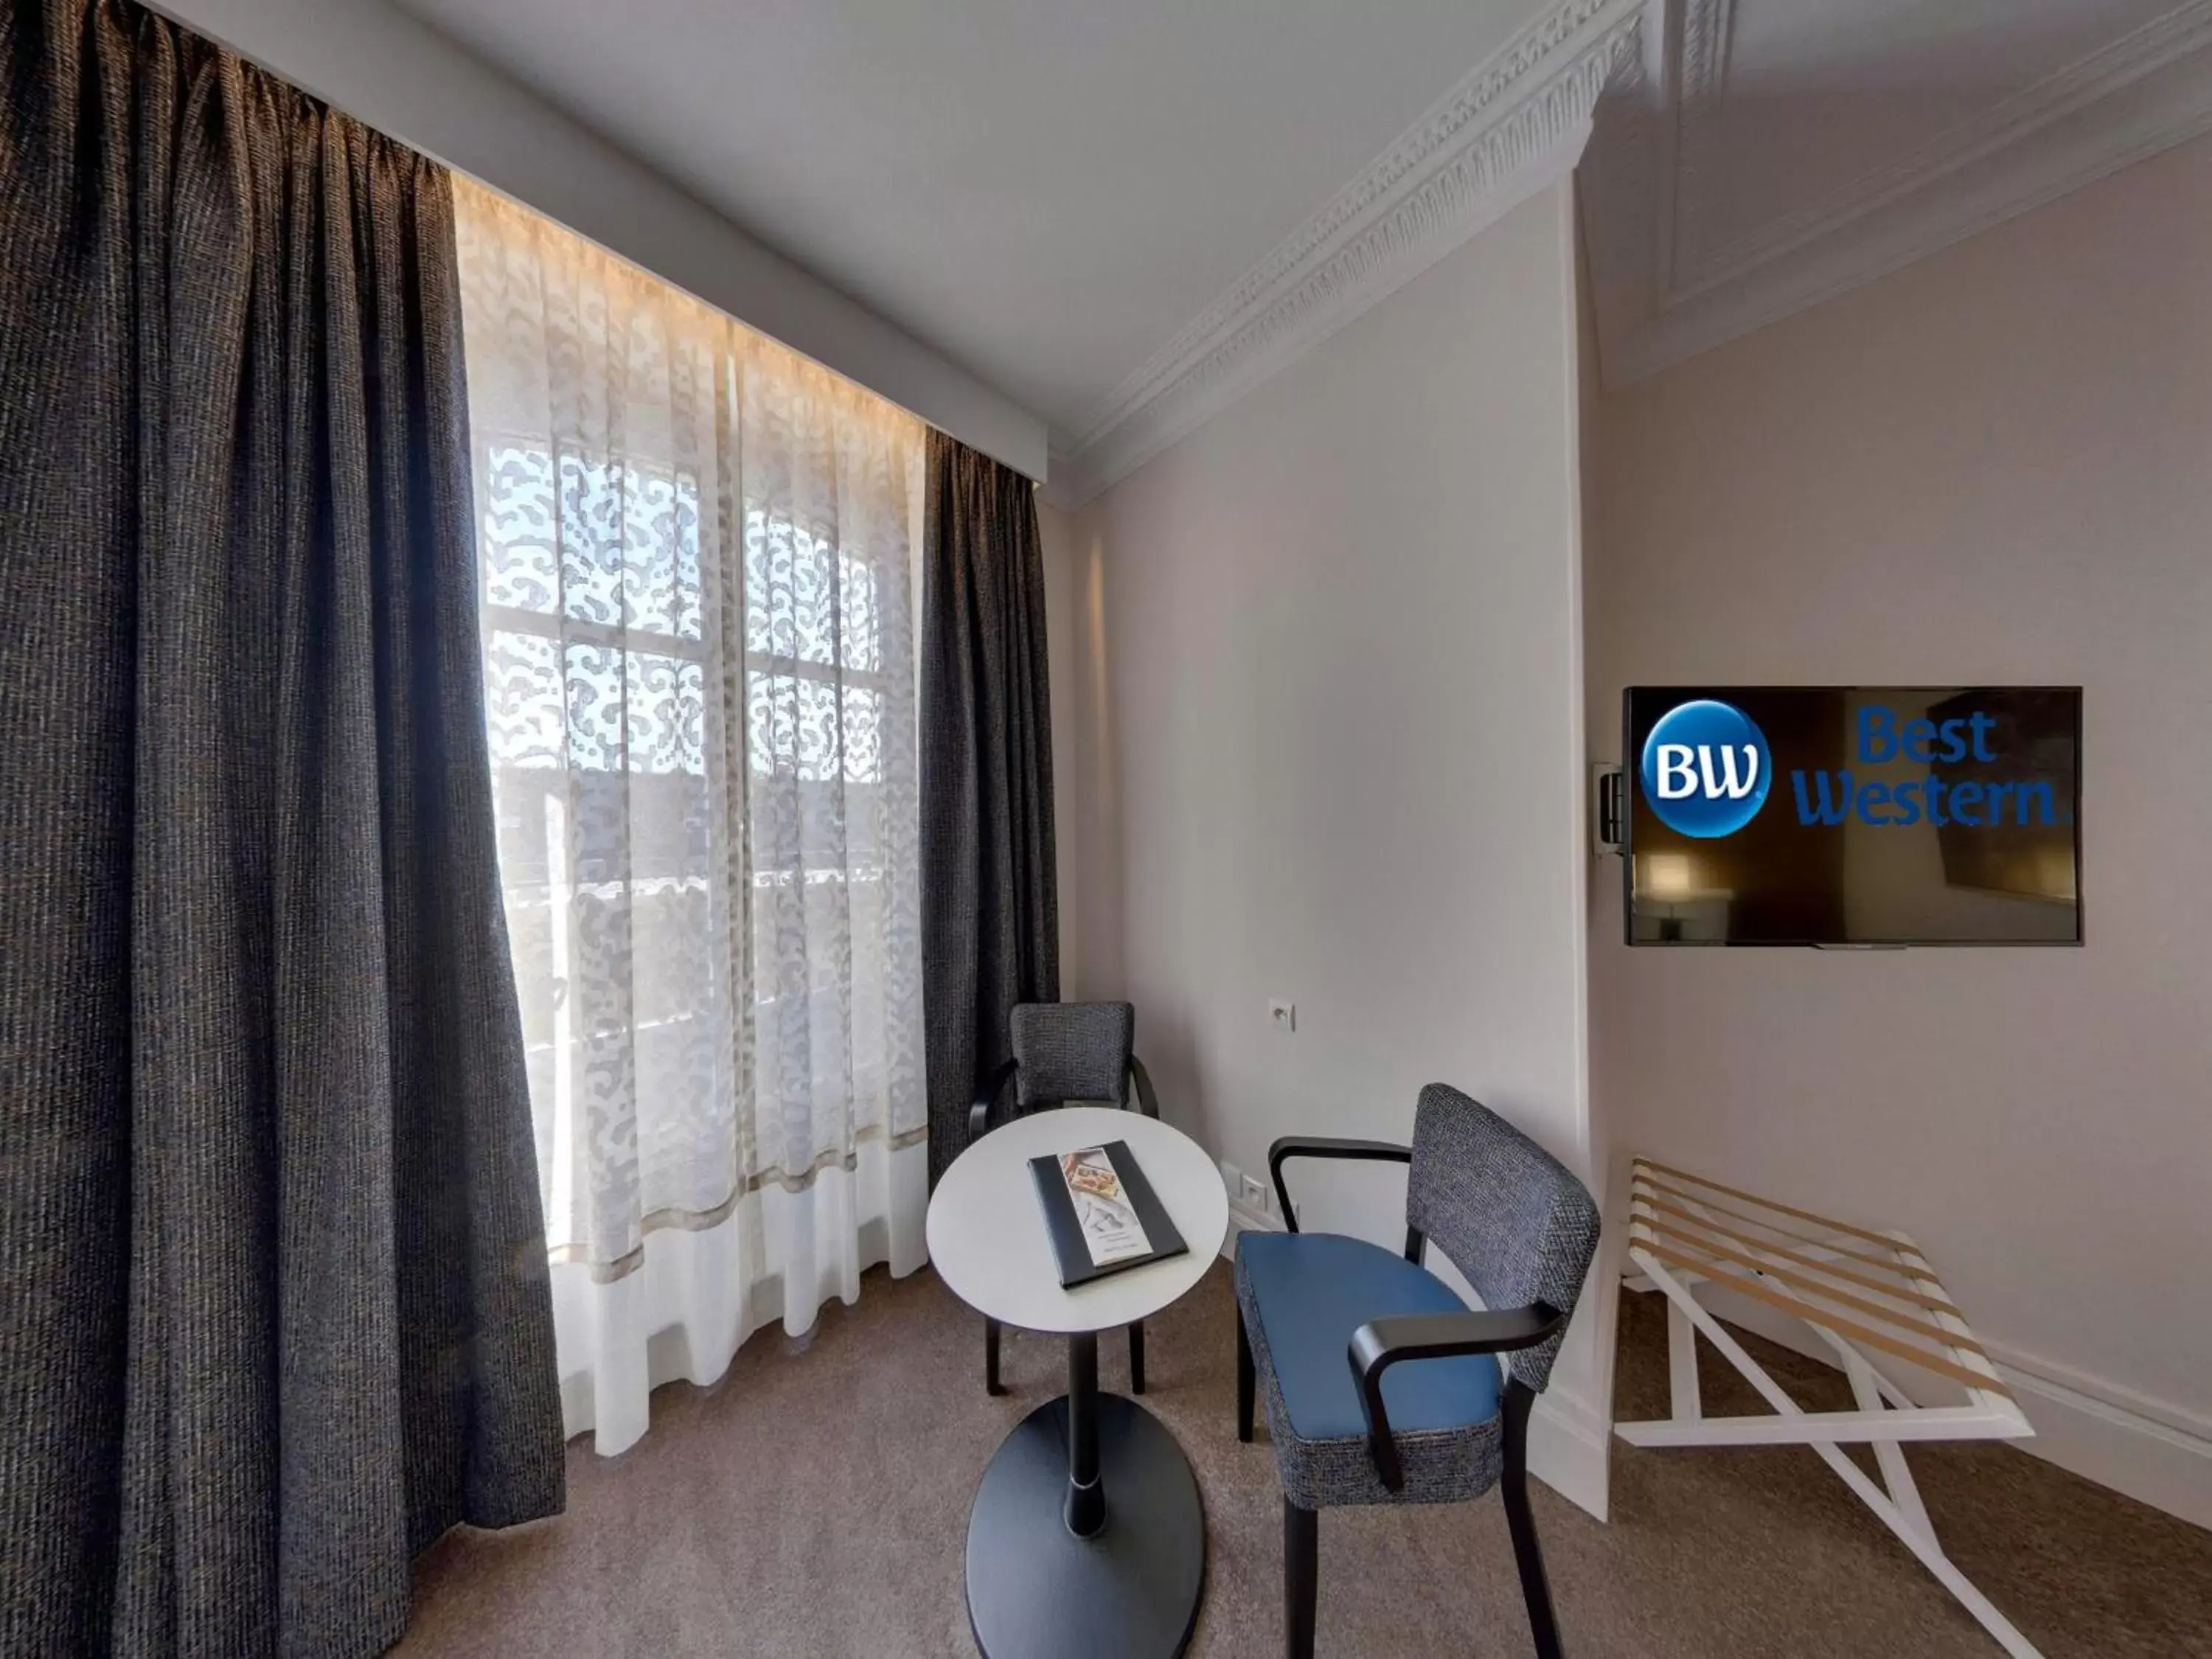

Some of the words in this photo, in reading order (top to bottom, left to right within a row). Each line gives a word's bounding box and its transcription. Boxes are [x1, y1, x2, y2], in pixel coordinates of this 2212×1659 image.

[1857, 704, 1998, 764] Best
[1658, 744, 1758, 799] BW
[1791, 769, 2057, 827] Western
